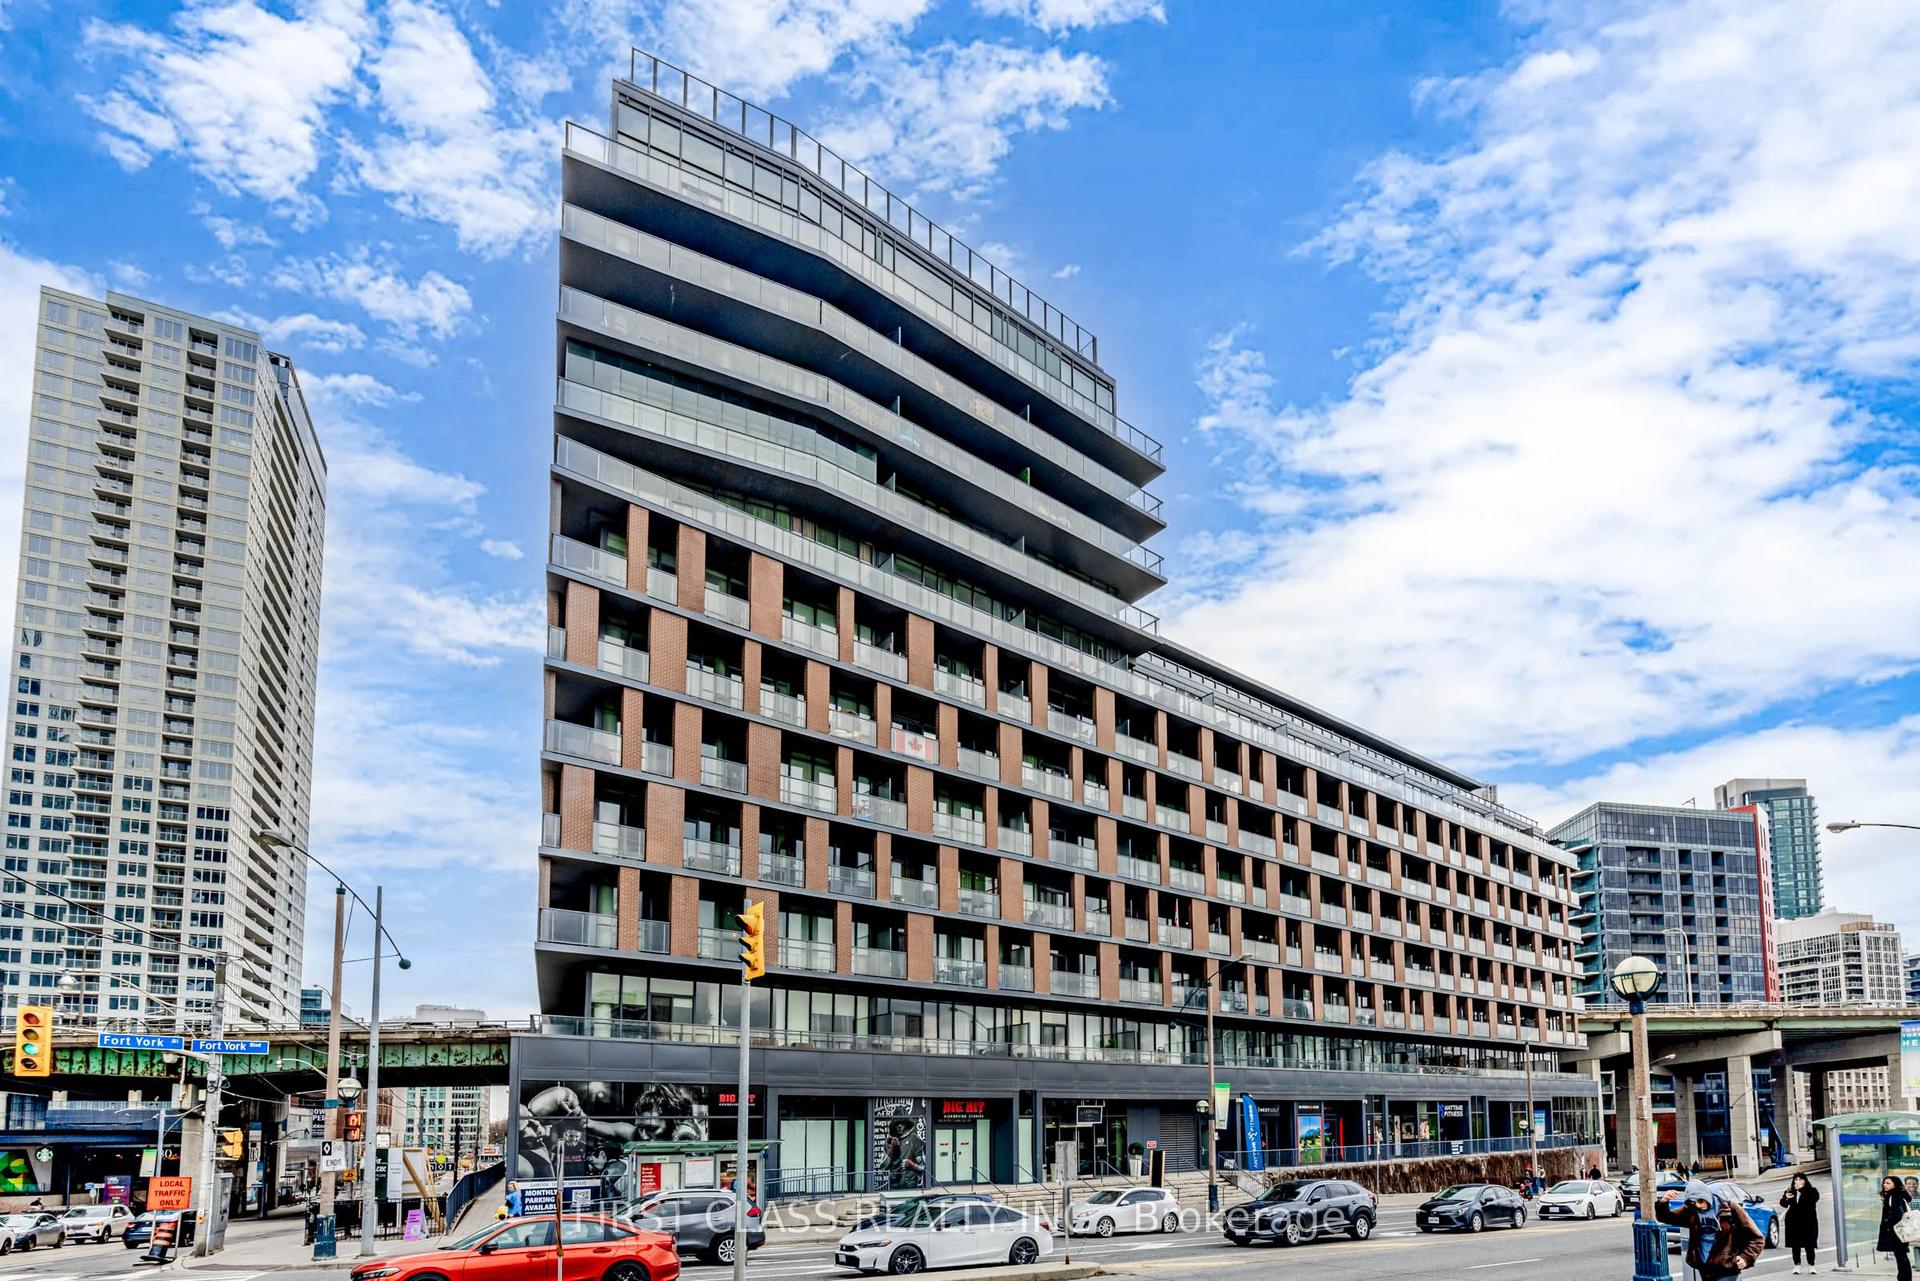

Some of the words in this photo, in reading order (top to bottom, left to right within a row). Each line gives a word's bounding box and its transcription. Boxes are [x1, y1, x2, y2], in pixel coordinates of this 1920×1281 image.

[104, 1035, 131, 1046] Fort
[136, 1037, 164, 1048] York
[199, 1040, 222, 1050] Fort
[223, 1041, 247, 1051] York
[719, 1094, 736, 1103] BIG
[943, 1100, 964, 1113] BIG
[965, 1100, 985, 1113] HIT
[160, 1180, 184, 1188] LOCAL
[155, 1189, 186, 1197] TRAFFIC
[525, 1189, 558, 1197] MONTHLY
[160, 1199, 181, 1207] ONLY
[525, 1204, 558, 1212] AVAILABL
